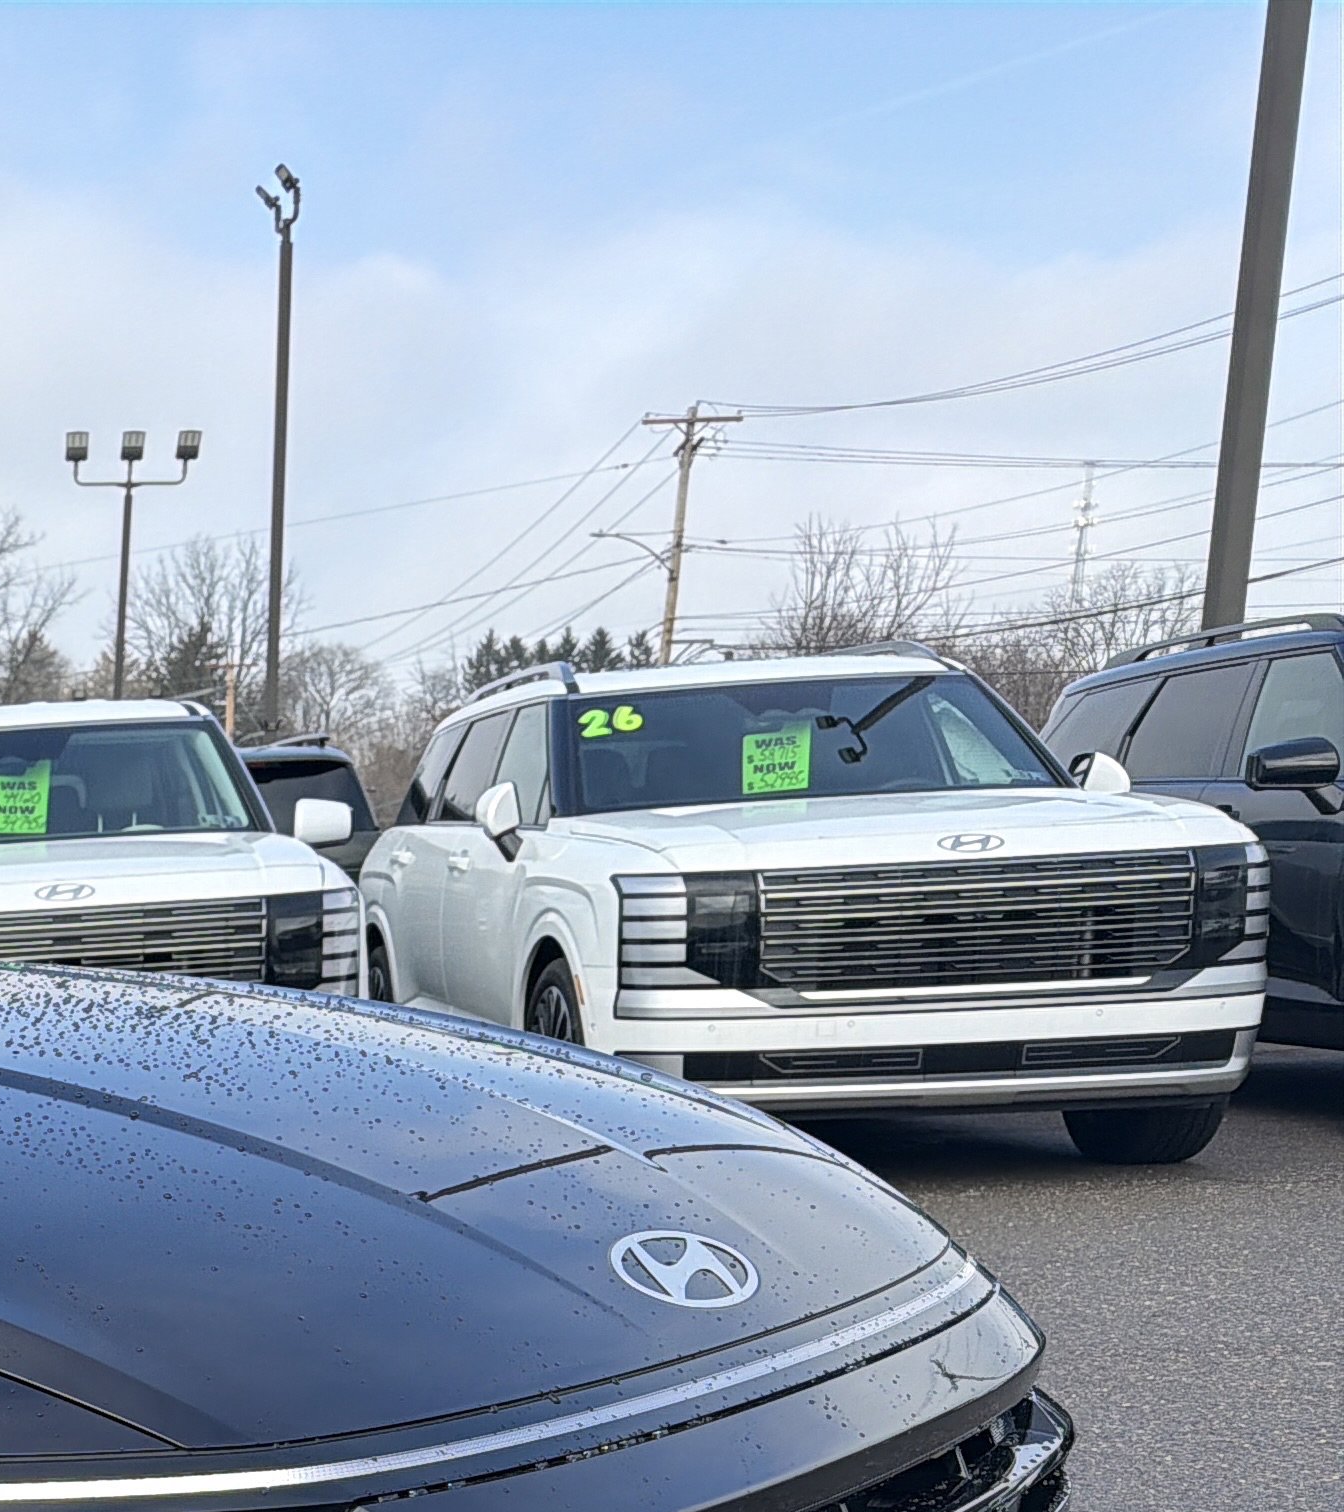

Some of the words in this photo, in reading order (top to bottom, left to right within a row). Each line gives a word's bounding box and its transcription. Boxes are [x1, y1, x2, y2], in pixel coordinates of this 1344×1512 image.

[577, 705, 644, 738] 26
[755, 735, 797, 749] WAS
[753, 760, 797, 774] NOW
[0, 781, 38, 791] WAS
